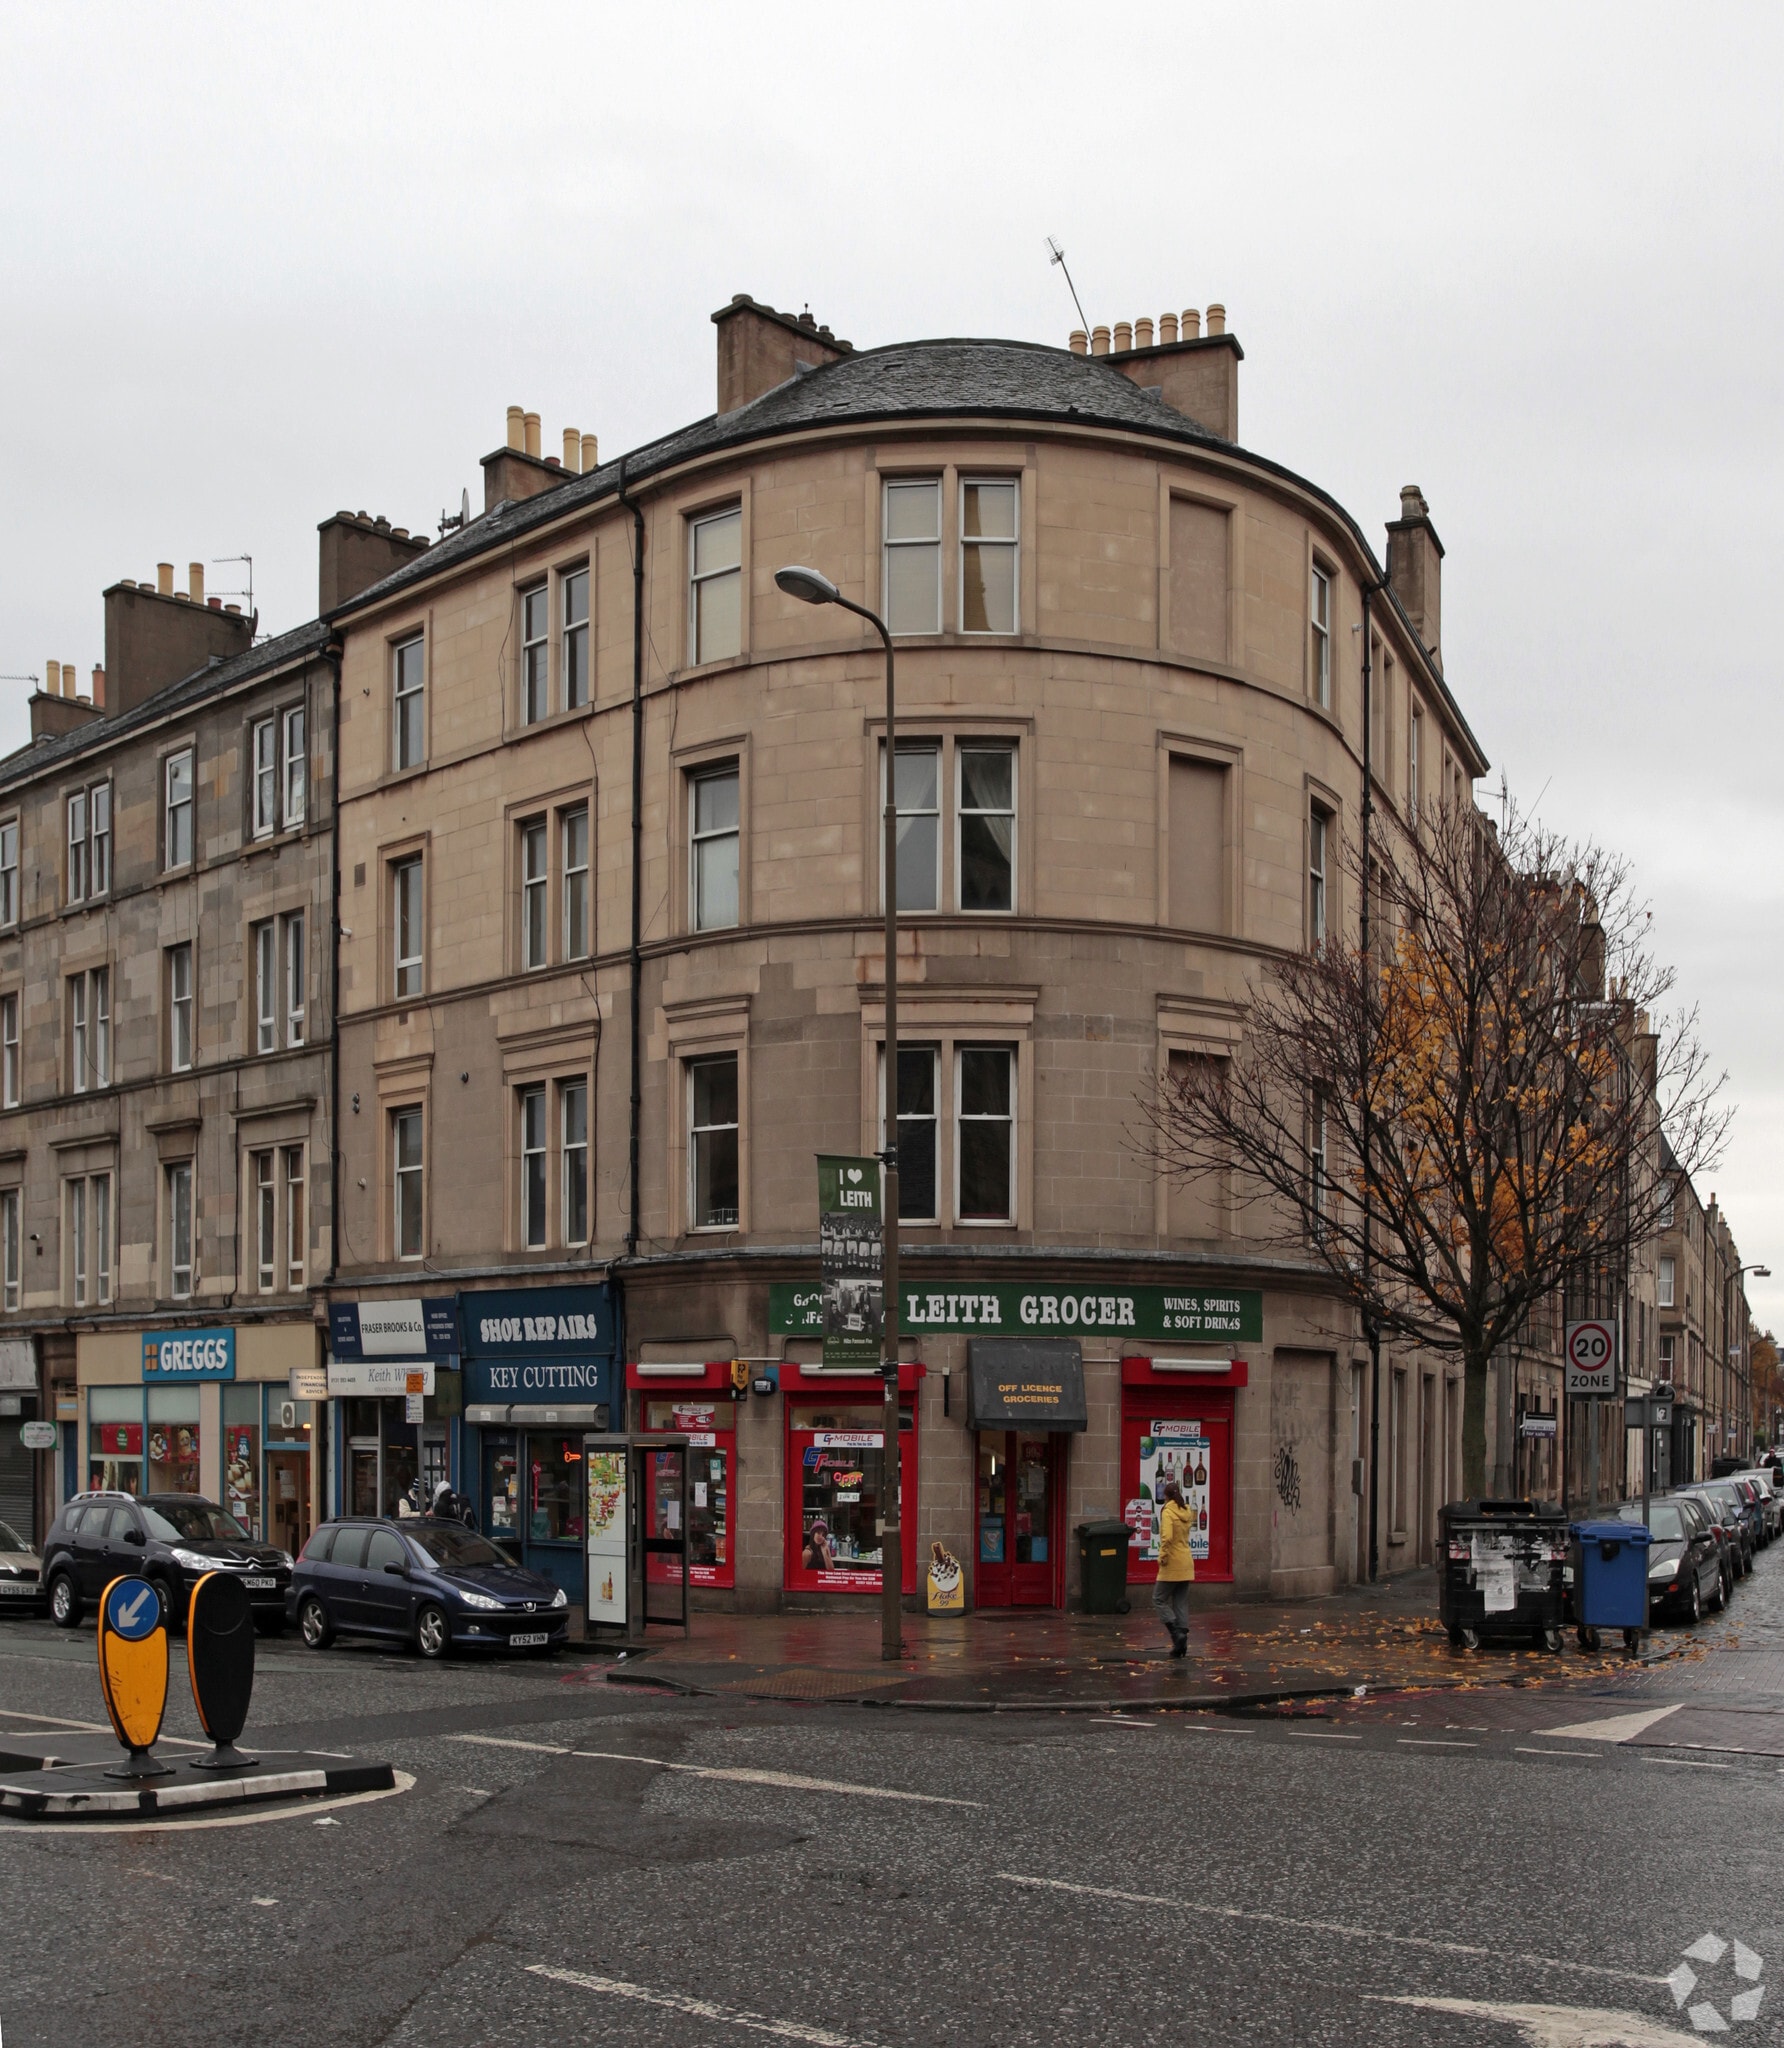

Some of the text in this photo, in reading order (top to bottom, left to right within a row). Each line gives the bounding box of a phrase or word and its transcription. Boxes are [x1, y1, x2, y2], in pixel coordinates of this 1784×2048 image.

[839, 1168, 843, 1185] I
[840, 1190, 872, 1207] LEITH
[906, 1294, 1002, 1323] LEITH
[1020, 1295, 1135, 1325] GROCER
[1163, 1297, 1240, 1313] WINES, SPIRITS
[361, 1324, 383, 1334] FRASER
[384, 1322, 407, 1333] BROOKS
[408, 1322, 413, 1332] &
[413, 1322, 424, 1332] Co.
[480, 1313, 597, 1343] SHOE REPAIRS
[1163, 1314, 1171, 1328] &
[1174, 1315, 1202, 1328] SOFT
[161, 1338, 228, 1371] GREGGS
[1576, 1338, 1606, 1357] 20
[368, 1368, 391, 1382] Keith
[489, 1365, 598, 1388] KEY CUTTING
[1571, 1375, 1609, 1387] ZONE
[998, 1384, 1062, 1392] OFF LICENCE
[1003, 1395, 1059, 1403] GROCERIES
[1166, 1425, 1200, 1433] MOBILE
